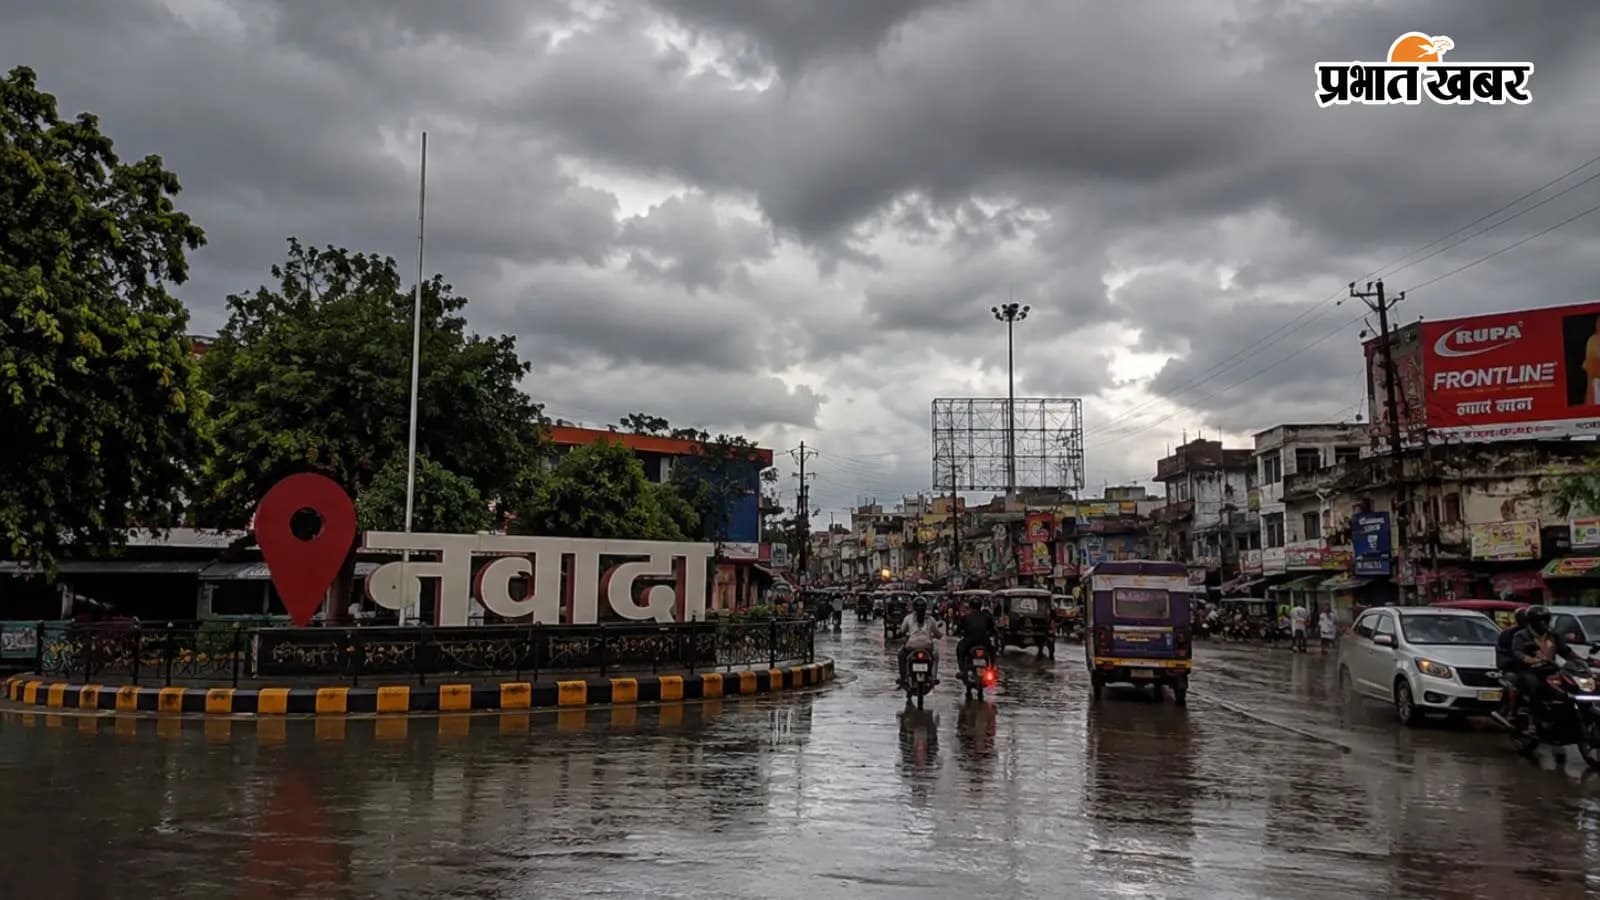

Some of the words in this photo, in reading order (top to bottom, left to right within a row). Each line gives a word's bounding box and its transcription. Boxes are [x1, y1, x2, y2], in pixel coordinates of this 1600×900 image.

[1455, 324, 1522, 345] RUPA
[1432, 363, 1555, 391] FRONTLINE
[364, 531, 714, 626] नवादा
